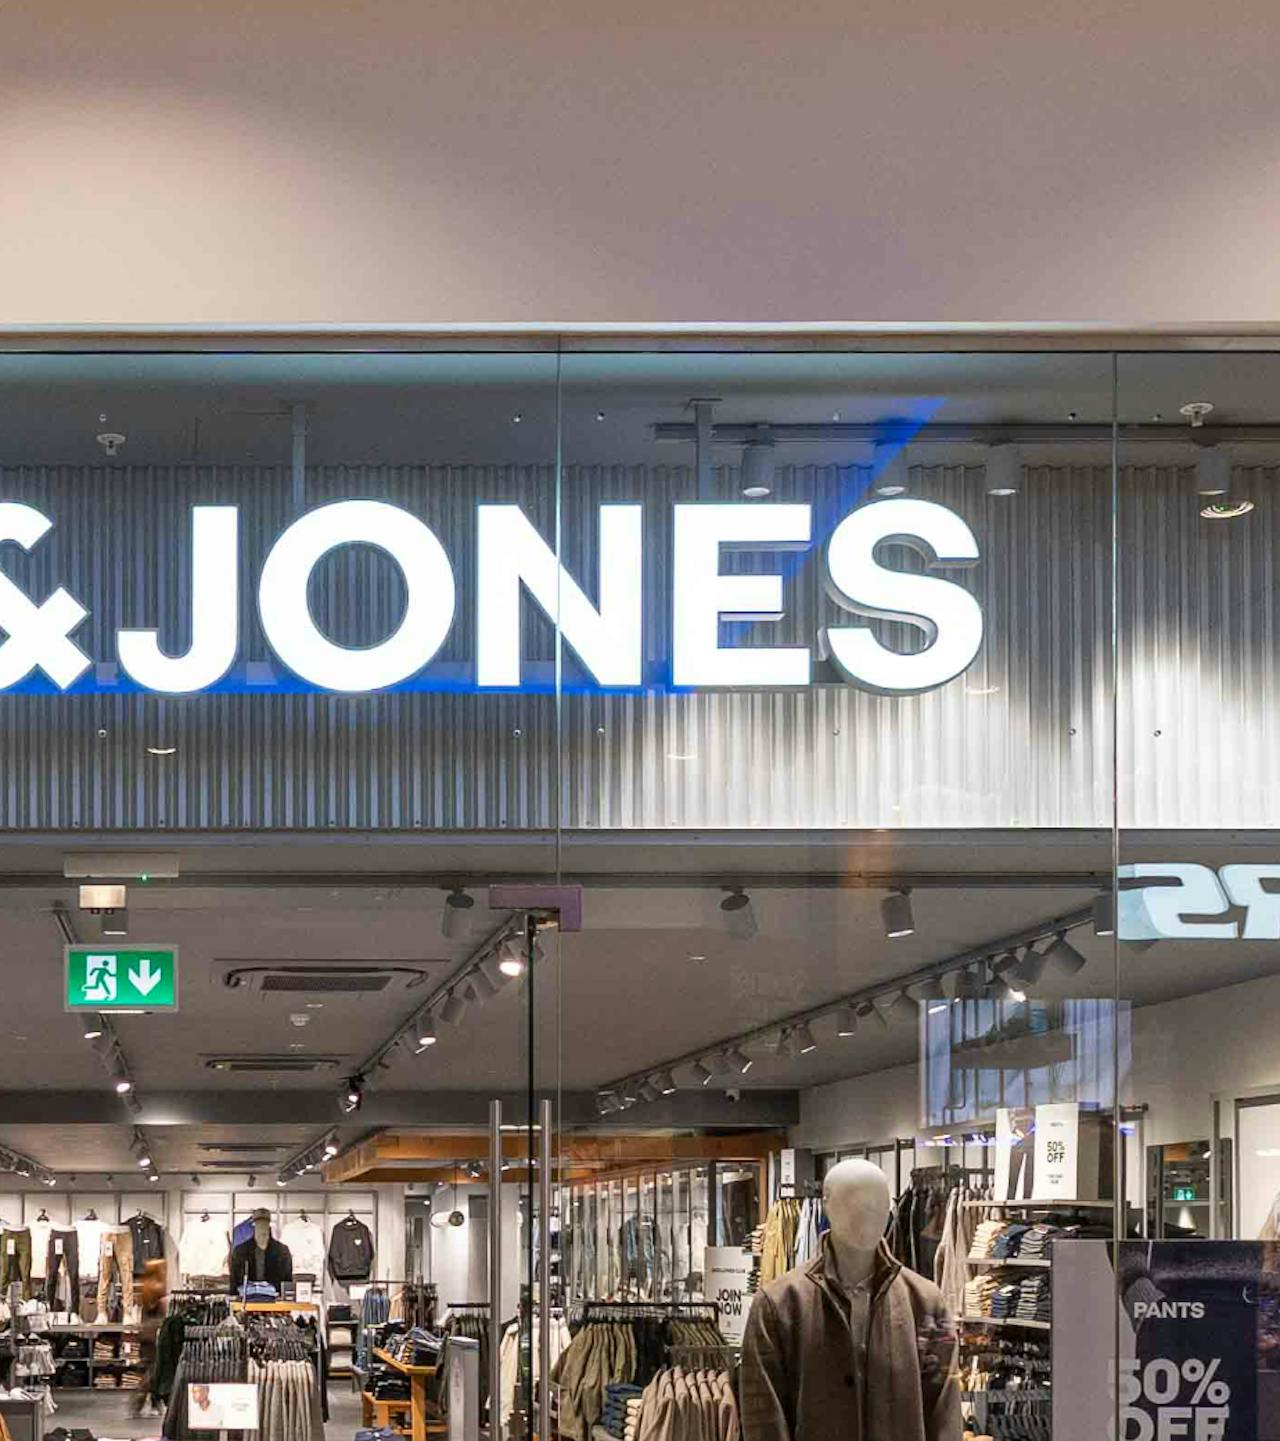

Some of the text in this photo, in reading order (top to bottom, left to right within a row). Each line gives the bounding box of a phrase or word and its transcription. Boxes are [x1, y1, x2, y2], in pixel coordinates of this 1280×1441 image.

[1047, 1141, 1065, 1152] 50%
[1047, 1153, 1065, 1163] OFF
[716, 1288, 742, 1302] JOIN
[718, 1302, 742, 1316] NOW
[1133, 1301, 1206, 1319] PANTS
[1108, 1357, 1231, 1404] 50%
[1108, 1404, 1230, 1441] OFF
